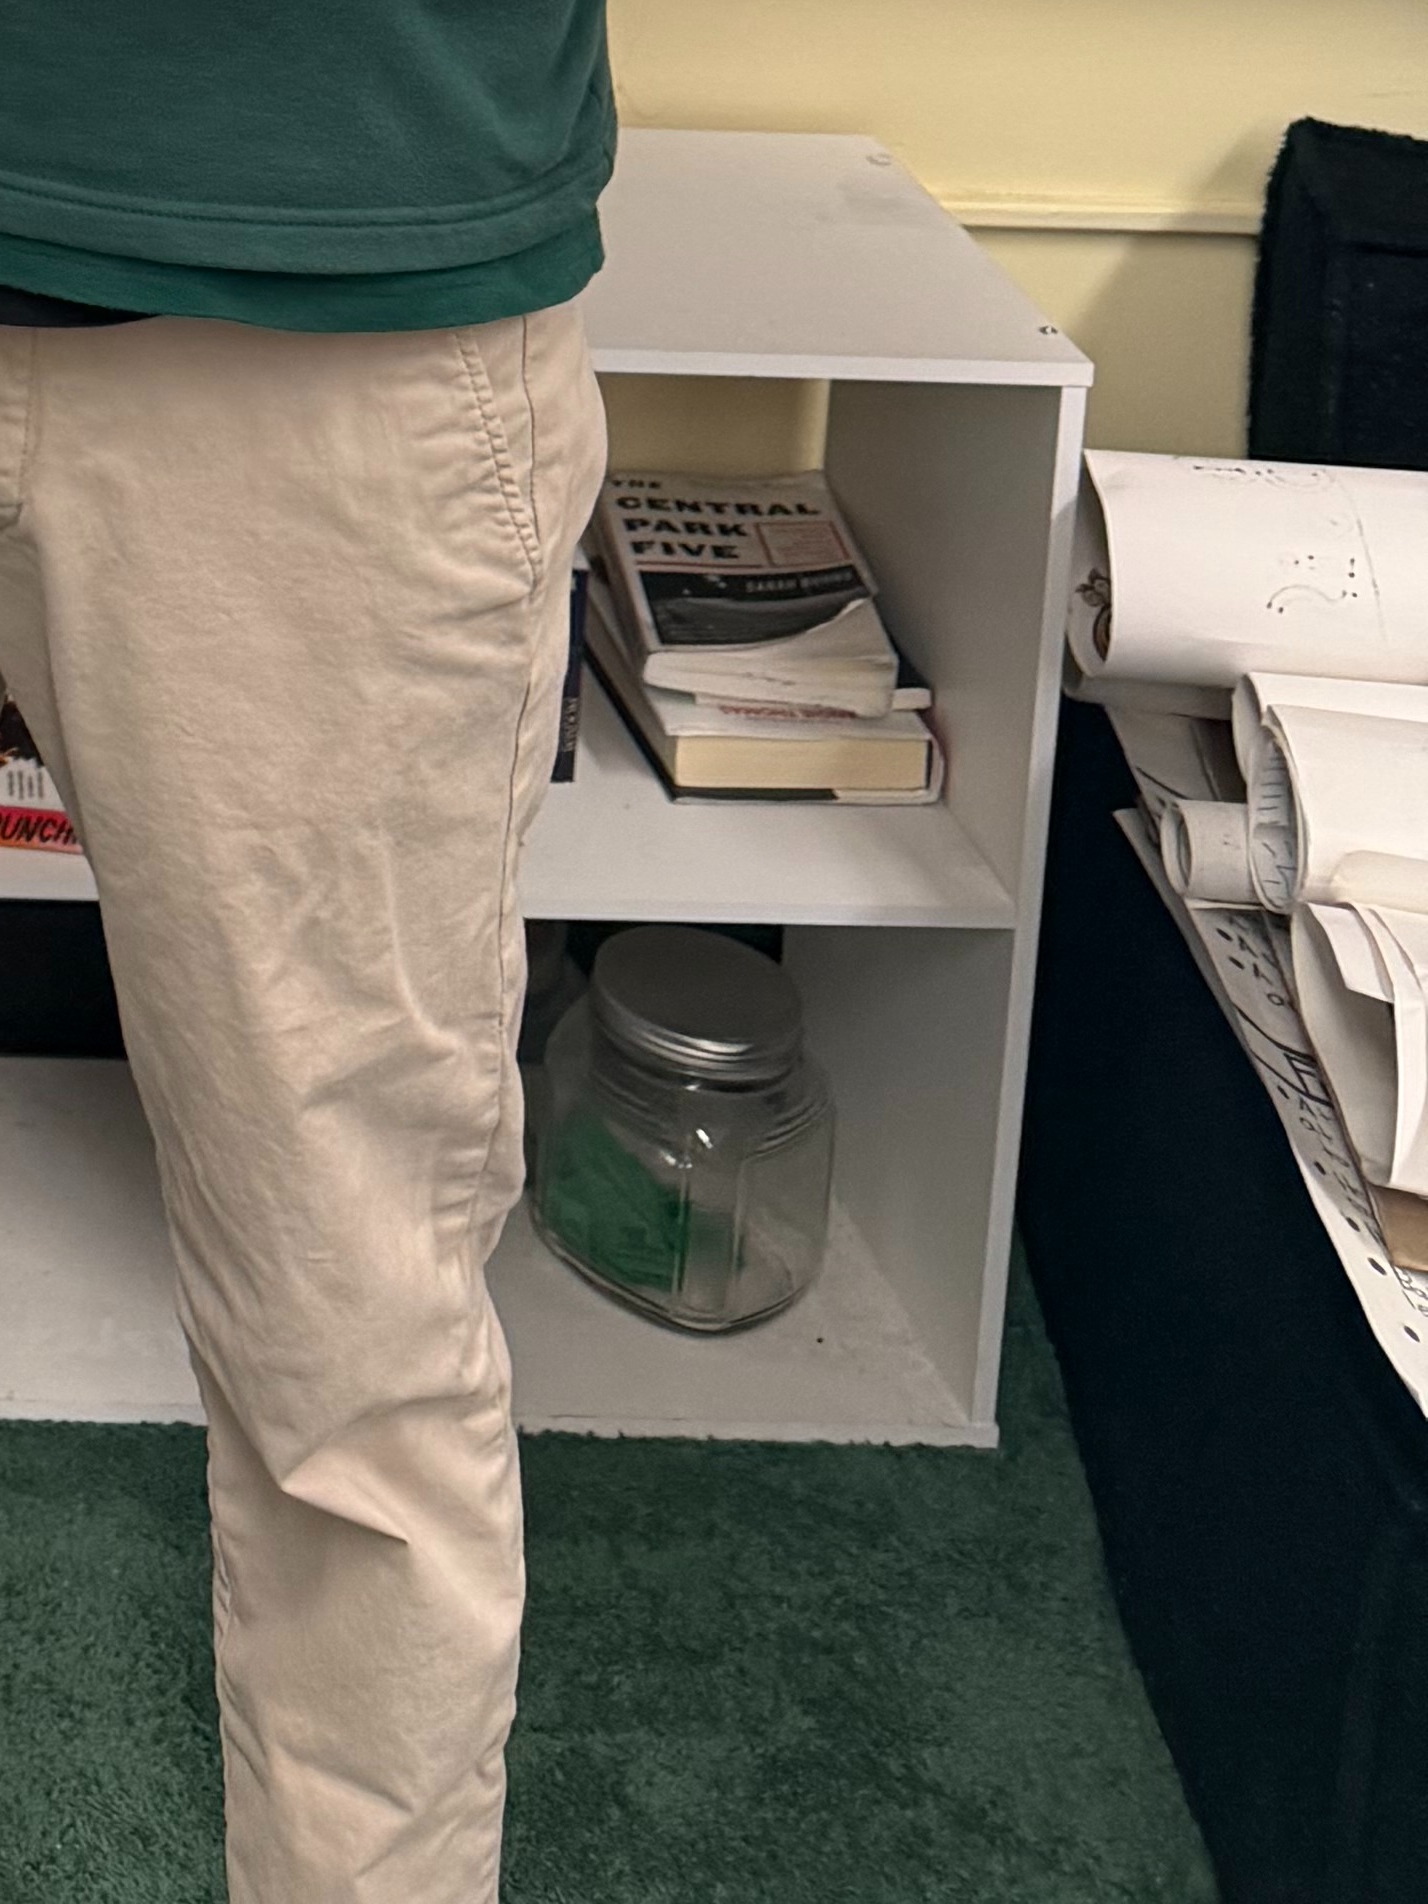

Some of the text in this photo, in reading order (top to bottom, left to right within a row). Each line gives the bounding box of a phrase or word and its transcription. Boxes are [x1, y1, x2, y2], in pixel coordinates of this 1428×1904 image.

[616, 496, 822, 517] CENTRAL
[622, 518, 748, 538] PARK
[629, 540, 741, 560] FIVE
